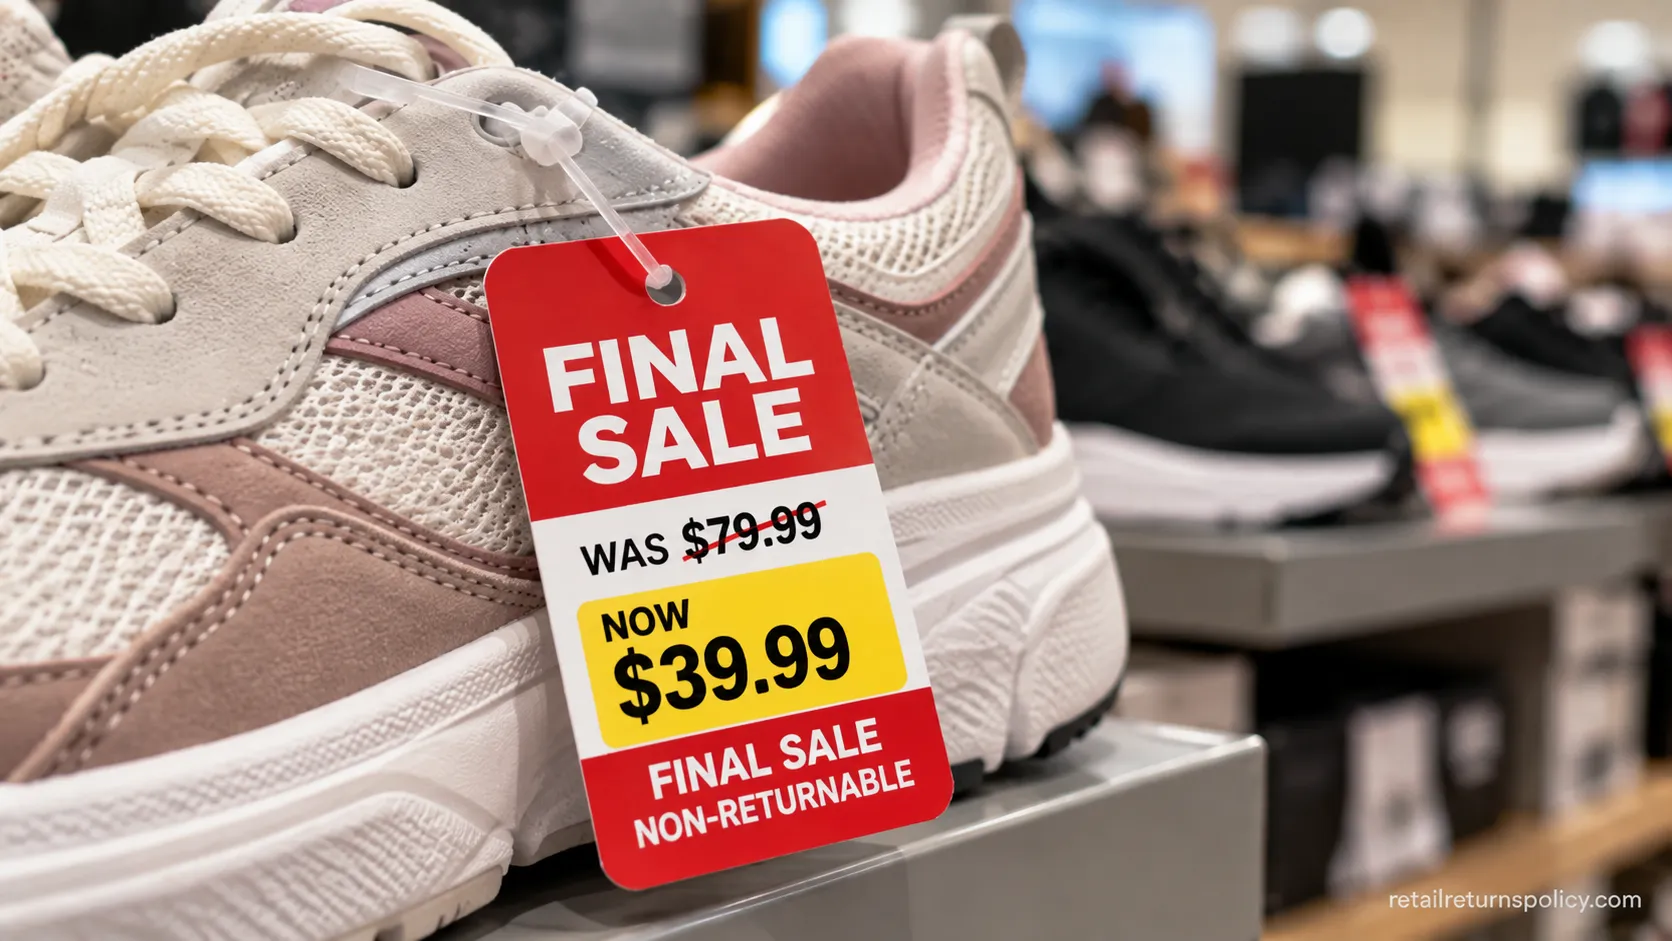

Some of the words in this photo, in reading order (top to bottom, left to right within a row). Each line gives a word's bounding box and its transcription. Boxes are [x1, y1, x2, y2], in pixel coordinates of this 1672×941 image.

[542, 317, 815, 414] FINAL
[576, 387, 813, 486] SALE
[580, 531, 670, 576] WAS
[683, 501, 823, 564] $79.99
[600, 598, 691, 643] NOW
[612, 616, 852, 727] $39.99
[632, 759, 916, 850] NON-RETURNABLE
[648, 743, 773, 801] FINAL
[780, 717, 883, 770] SALE
